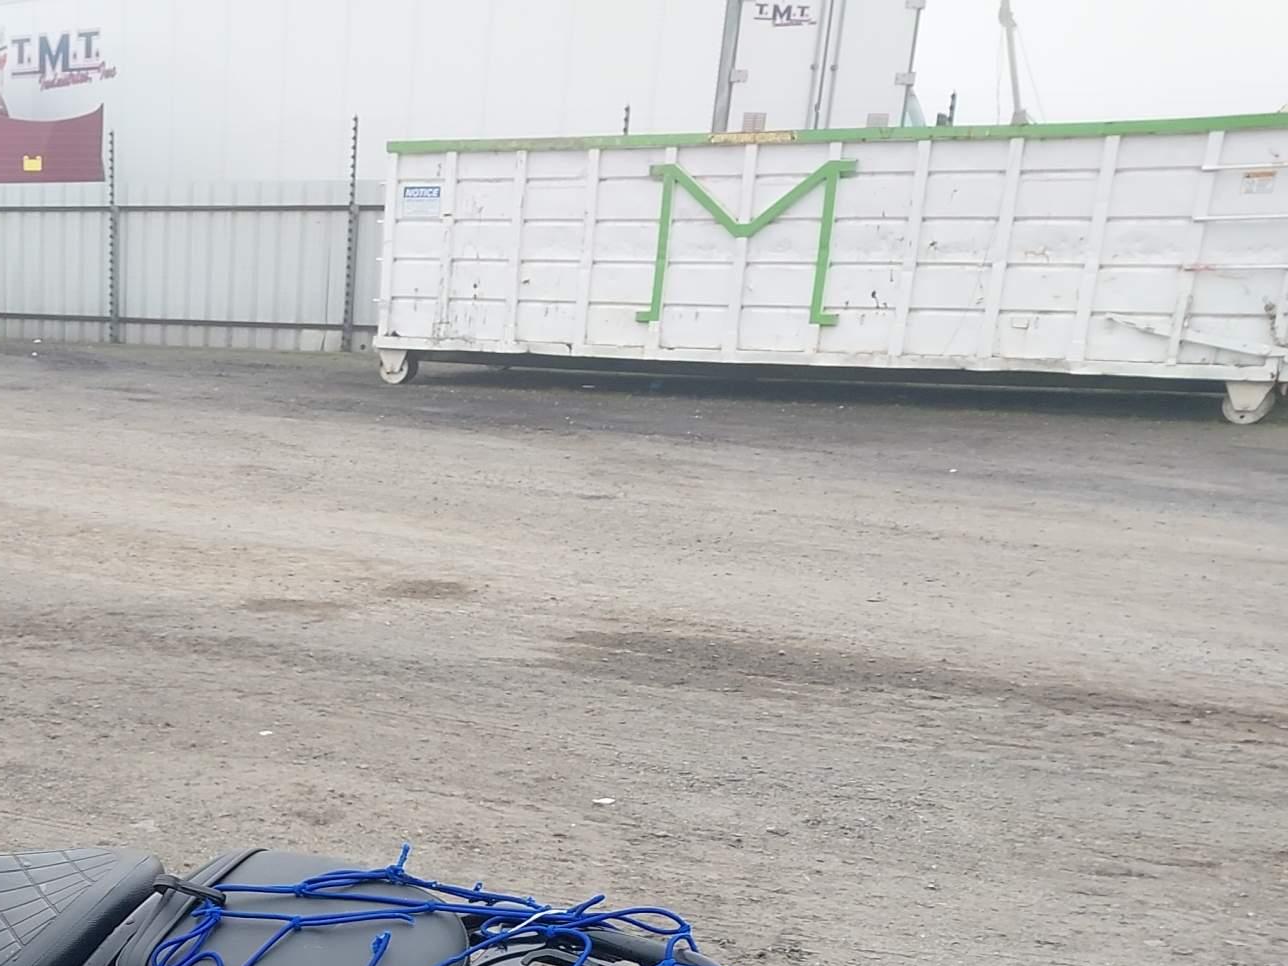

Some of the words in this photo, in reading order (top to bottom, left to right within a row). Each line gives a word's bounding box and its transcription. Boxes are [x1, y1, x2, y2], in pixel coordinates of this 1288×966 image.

[755, 3, 810, 21] T.M.T.
[11, 31, 101, 74] T.M.T.
[405, 188, 440, 198] NOTICE
